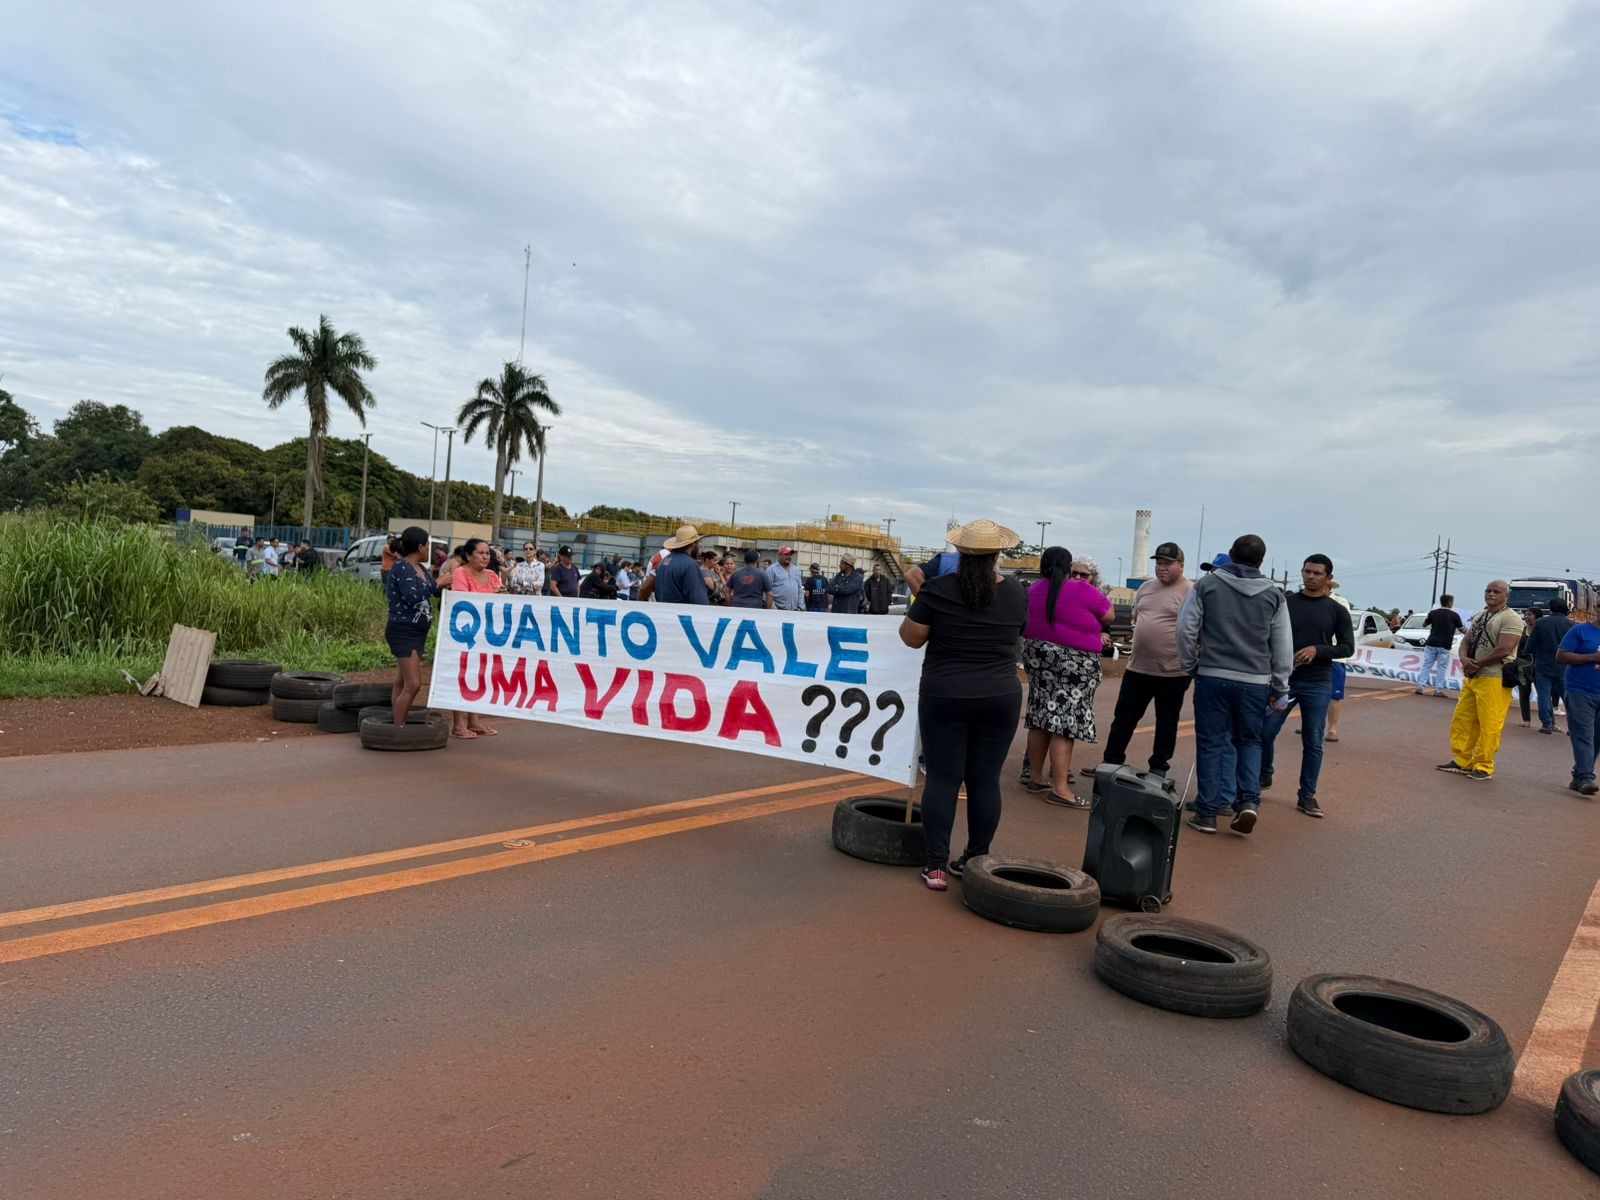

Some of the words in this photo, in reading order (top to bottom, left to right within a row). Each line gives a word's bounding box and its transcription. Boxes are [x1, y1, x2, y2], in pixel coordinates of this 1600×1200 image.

[449, 600, 658, 661] QUANTO
[678, 614, 870, 685] VALE
[458, 651, 559, 713] UMA
[575, 662, 783, 748] VIDA
[801, 684, 905, 766] ???
